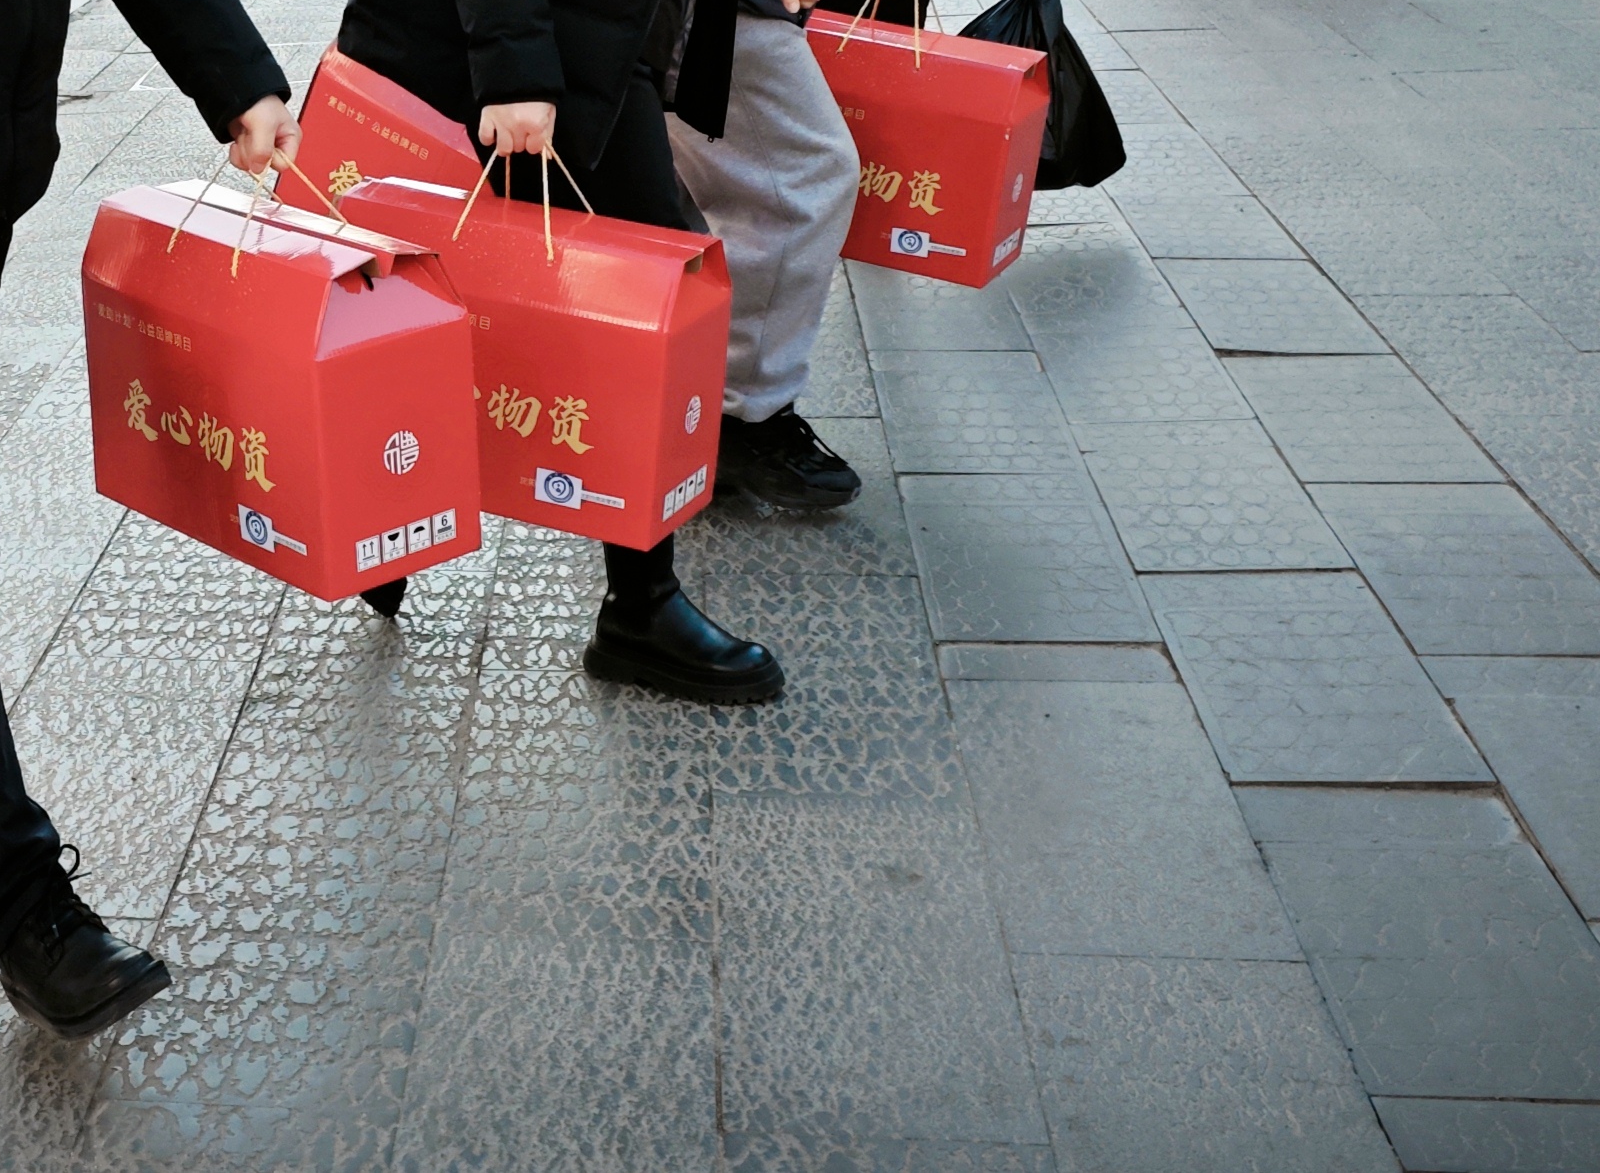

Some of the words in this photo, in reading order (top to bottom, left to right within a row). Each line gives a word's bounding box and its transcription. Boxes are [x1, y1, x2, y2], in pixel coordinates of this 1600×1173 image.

[859, 161, 945, 216] 物资
[123, 378, 277, 493] 爱心物资
[474, 383, 595, 455] 物资
[441, 515, 448, 527] 6
